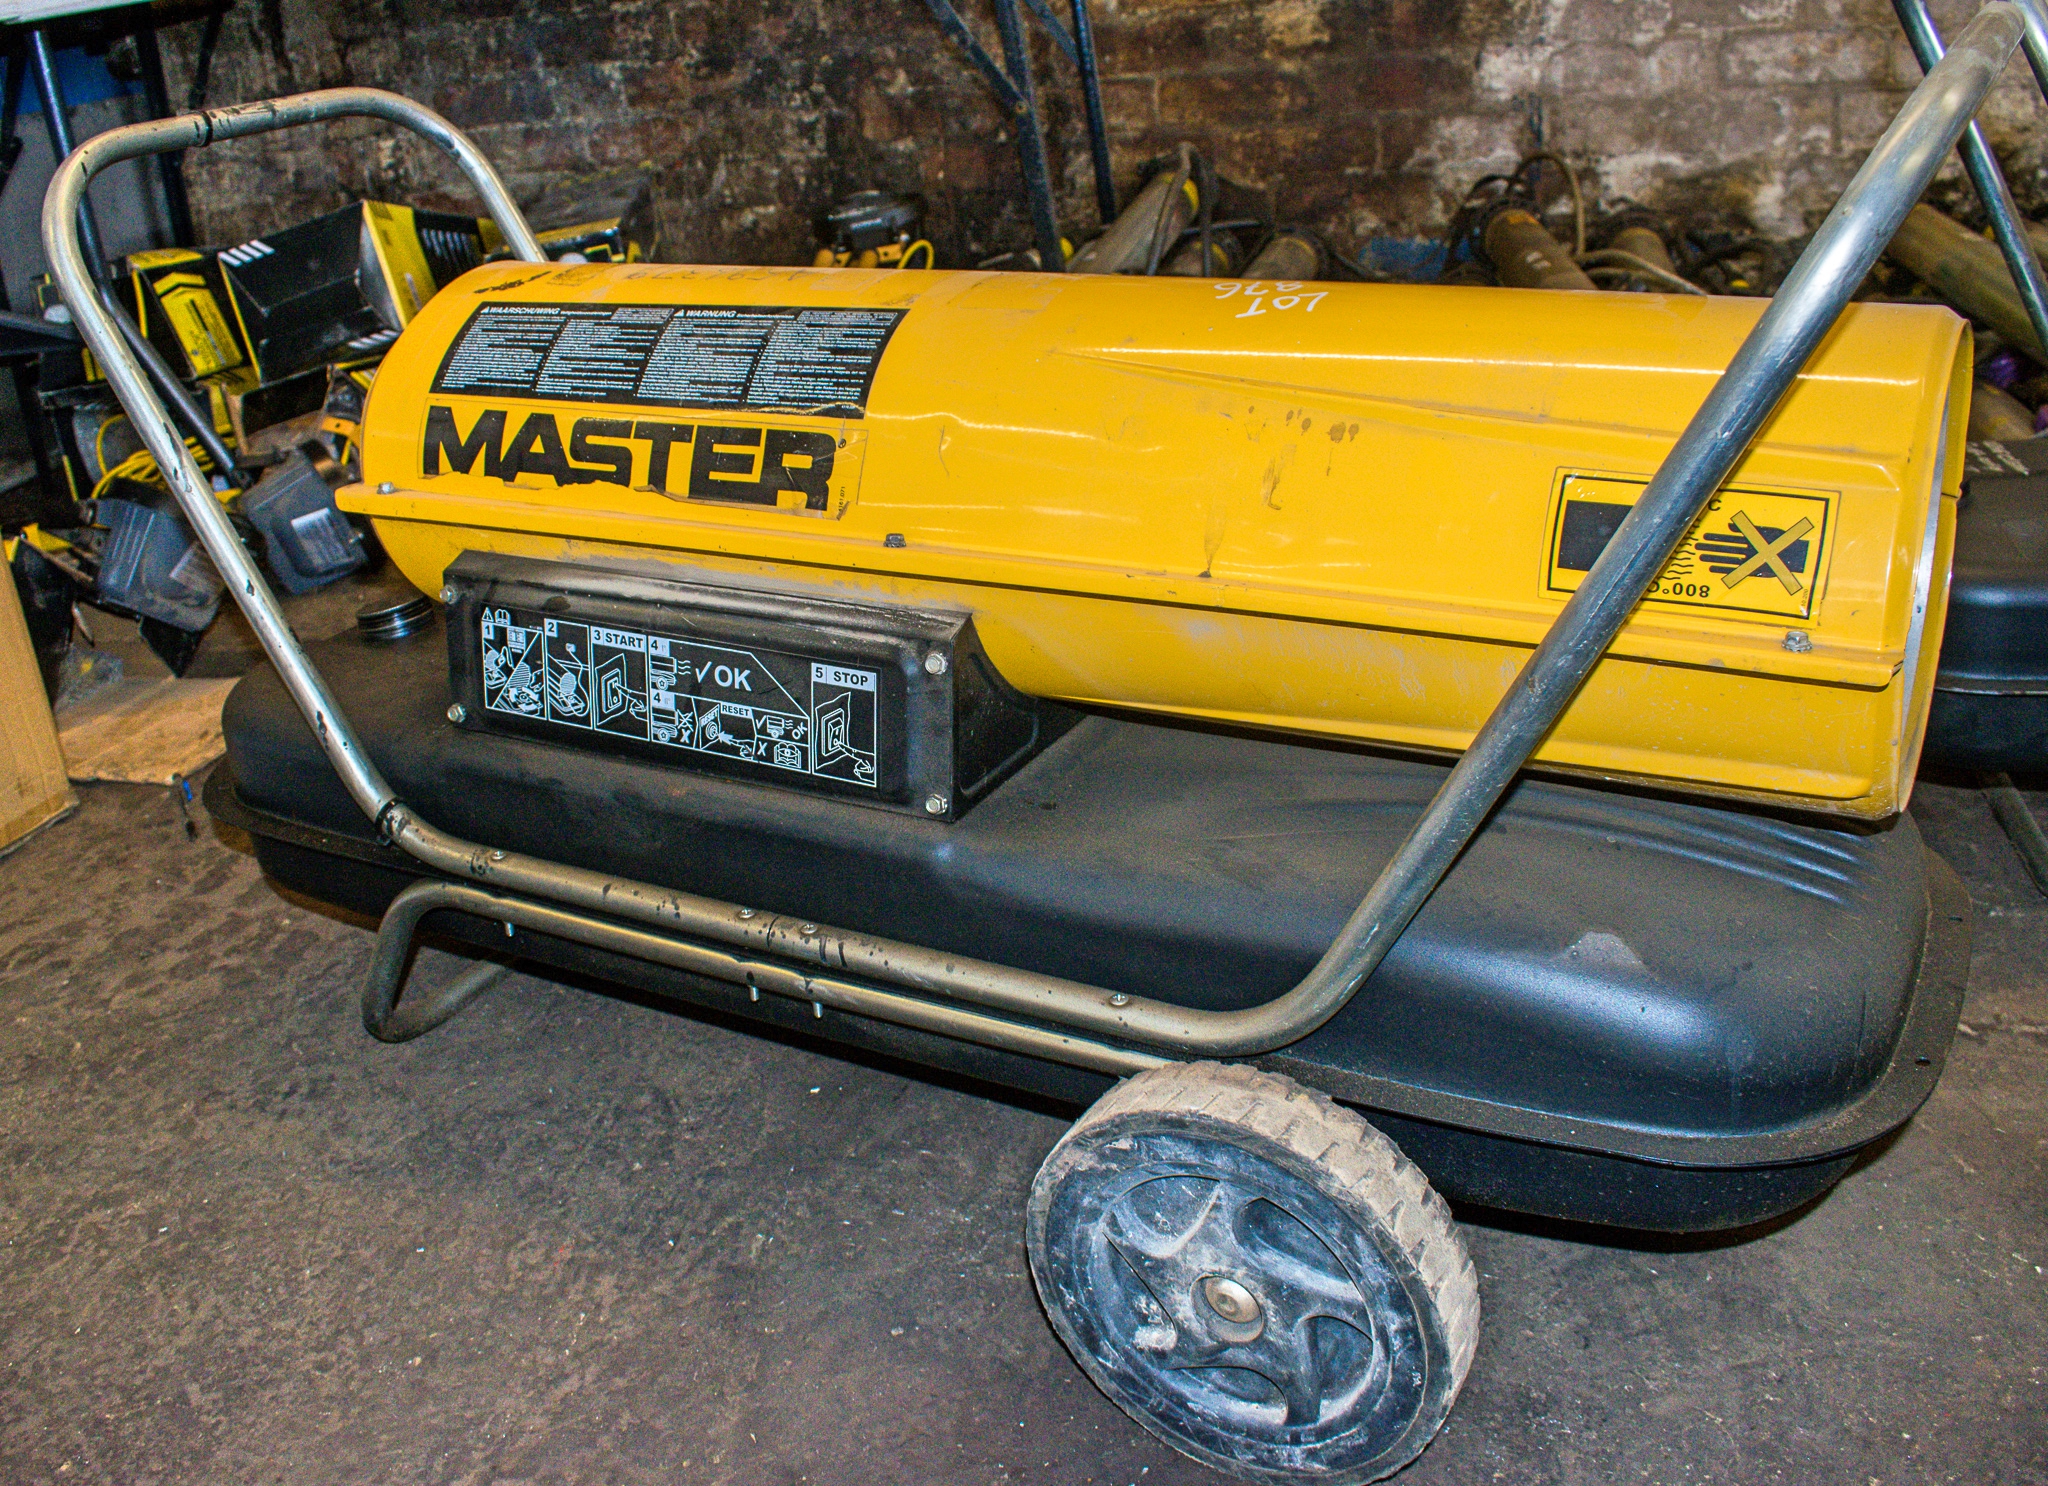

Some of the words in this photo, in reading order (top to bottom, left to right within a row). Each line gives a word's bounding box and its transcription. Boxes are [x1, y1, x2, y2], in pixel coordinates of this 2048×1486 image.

[685, 309, 737, 318] WARNUNG
[1235, 291, 1329, 319] LOT
[423, 405, 837, 512] MASTER
[547, 622, 555, 633] 2
[593, 630, 601, 641] 3
[605, 632, 643, 649] START
[650, 639, 659, 651] 4
[714, 664, 752, 692] OK
[814, 667, 824, 679] 5
[833, 671, 869, 687] STOP
[653, 692, 662, 703] 4
[722, 704, 750, 717] RESET
[791, 721, 808, 740] OK
